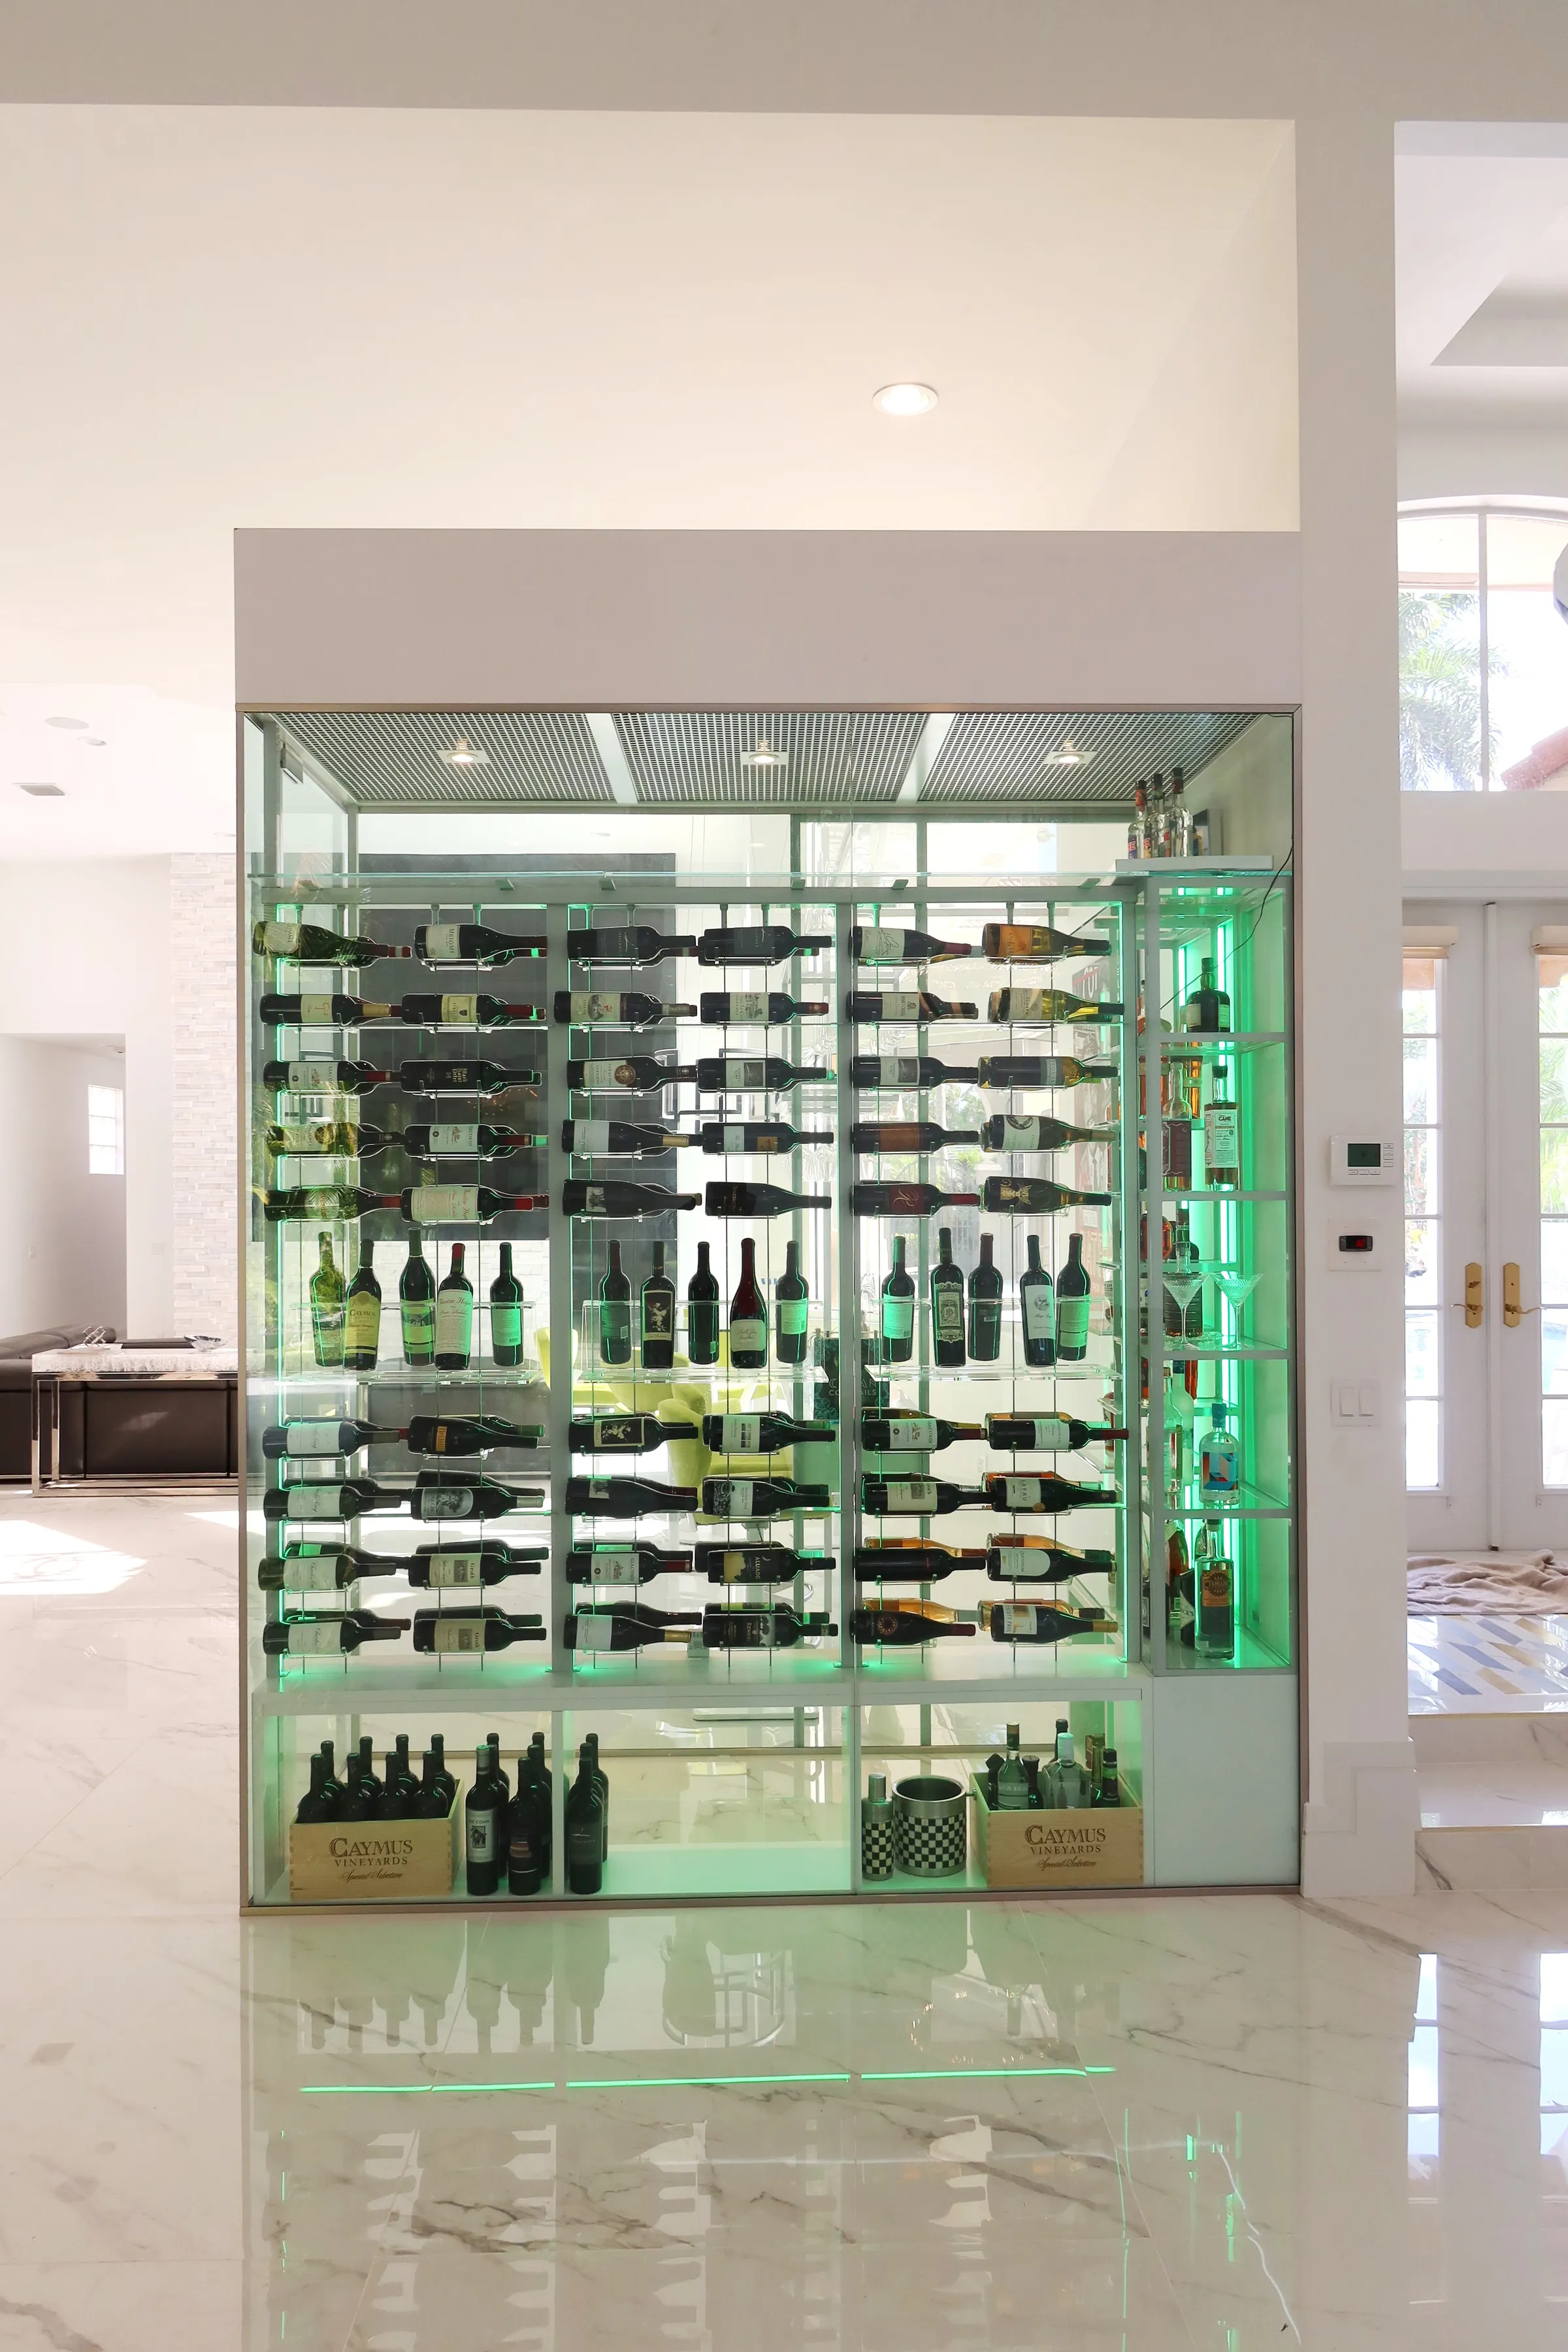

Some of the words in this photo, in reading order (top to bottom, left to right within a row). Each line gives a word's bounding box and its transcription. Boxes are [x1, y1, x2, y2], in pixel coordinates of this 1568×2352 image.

[1024, 1825, 1106, 1845] CAYMUS
[329, 1837, 413, 1857] CAYMUS
[1030, 1845, 1101, 1854] VINEYARDS
[335, 1856, 408, 1867] VINEYARDS
[1037, 1856, 1064, 1871] Special
[1064, 1855, 1097, 1867] Selection
[341, 1869, 371, 1884] Special
[370, 1868, 402, 1880] Selection
